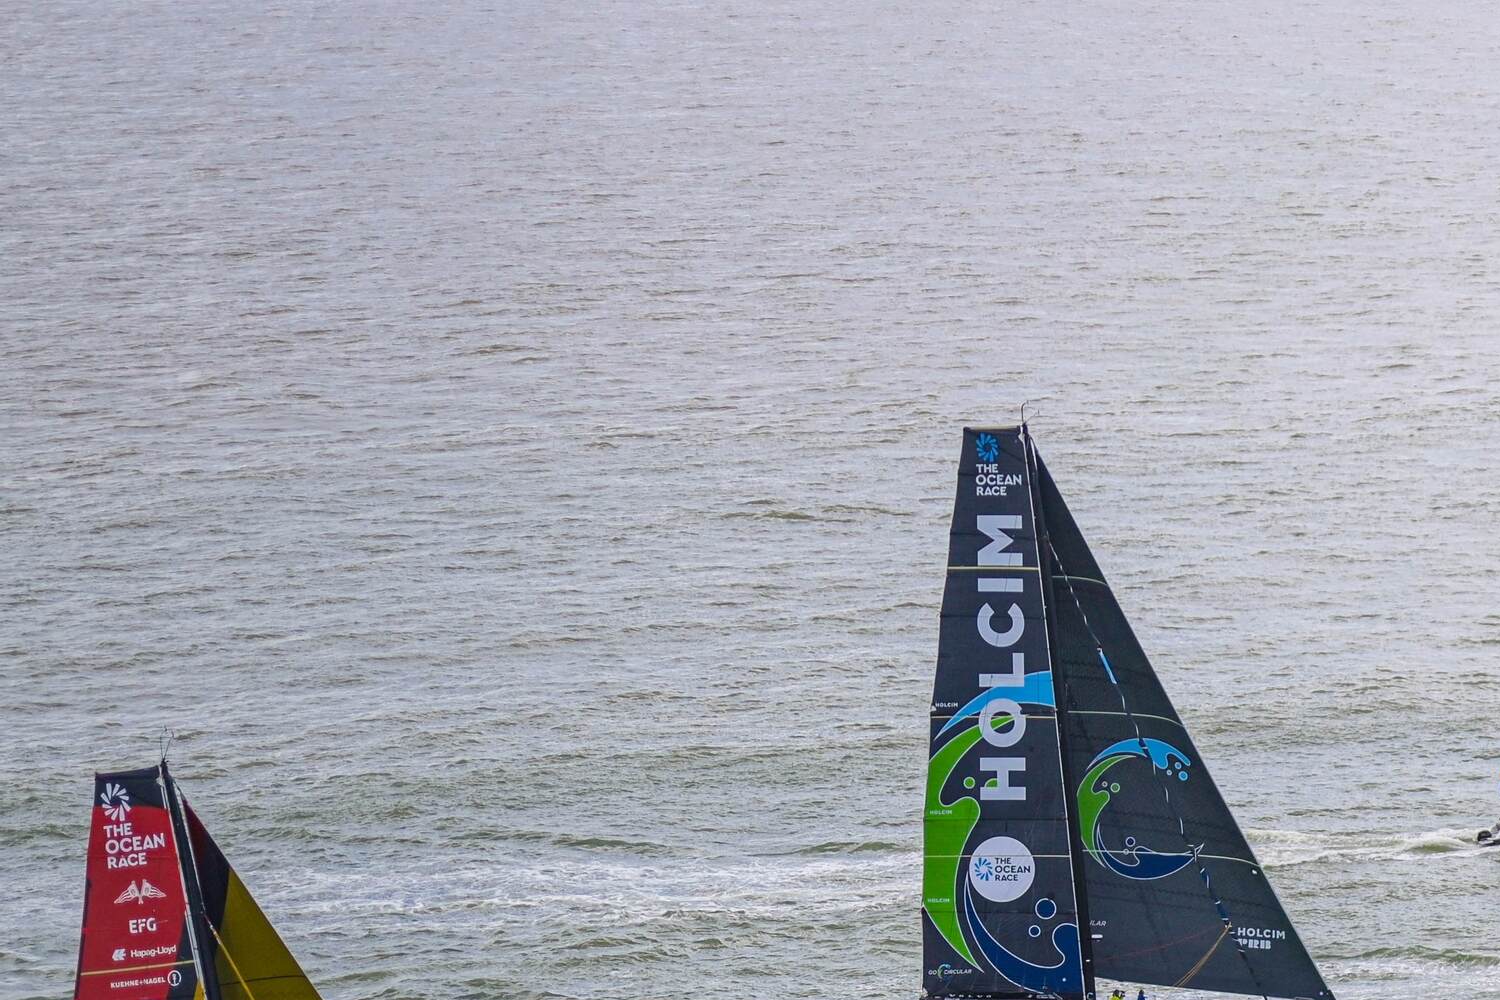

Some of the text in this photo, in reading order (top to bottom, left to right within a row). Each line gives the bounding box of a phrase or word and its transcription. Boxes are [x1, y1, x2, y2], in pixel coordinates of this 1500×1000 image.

[976, 463, 998, 474] THE
[975, 474, 1022, 485] OCEAN
[976, 486, 1007, 496] RACE
[976, 514, 1027, 801] HOLCIM
[103, 822, 132, 837] THE
[104, 832, 165, 855] OCEAN
[107, 853, 148, 869] RACE
[995, 857, 1012, 865] THE
[994, 865, 1031, 874] OCEAN
[994, 874, 1019, 882] RACE
[128, 917, 157, 934] EFG
[1237, 926, 1286, 940] HOLCIM
[130, 944, 177, 959] Hapag-Lloyd
